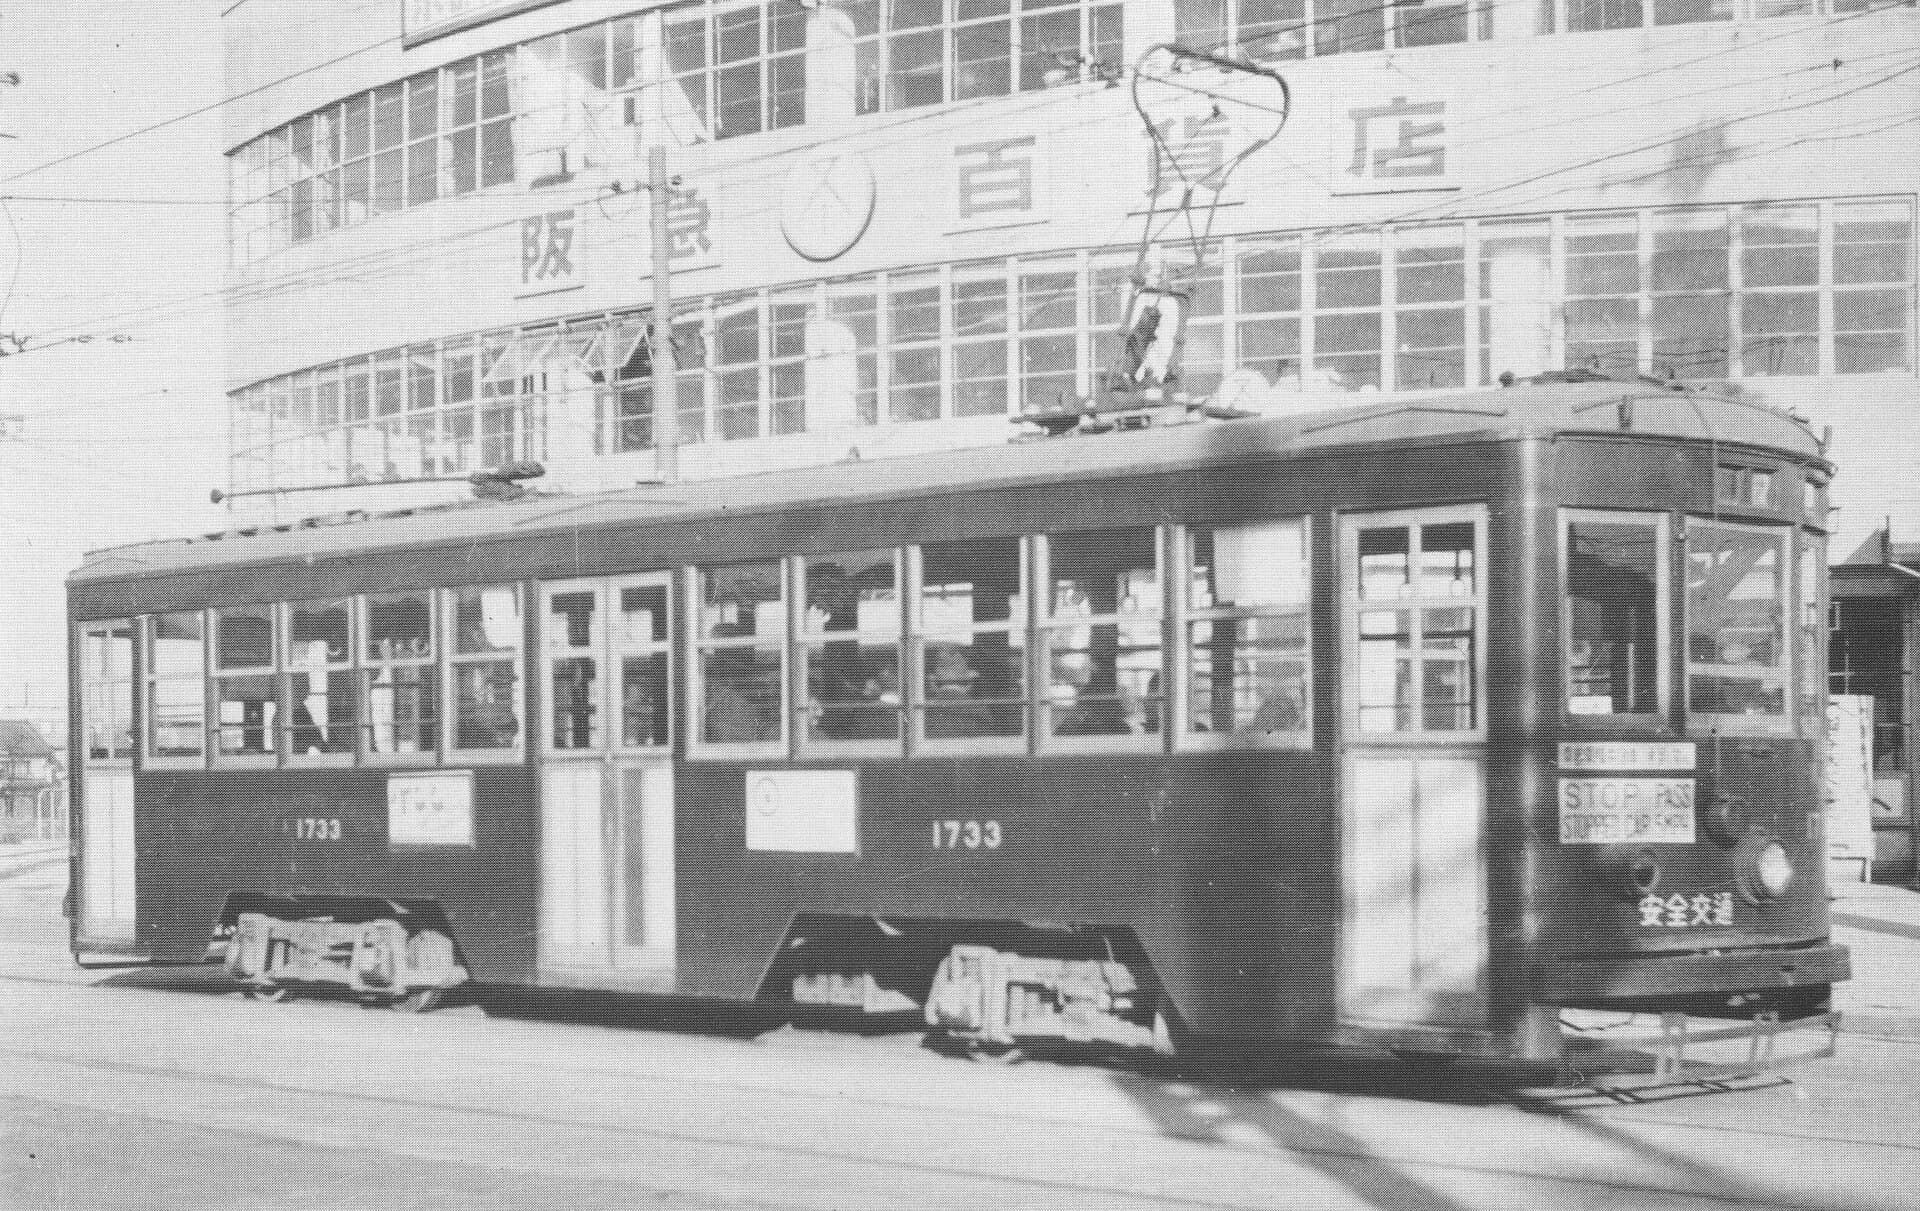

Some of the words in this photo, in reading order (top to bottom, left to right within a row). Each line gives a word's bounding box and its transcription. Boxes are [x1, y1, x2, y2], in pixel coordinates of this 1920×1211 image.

[1566, 783, 1640, 809] STOP
[297, 818, 342, 840] 1733
[932, 820, 1001, 849] 1733
[1638, 891, 1733, 927] 安全交通
